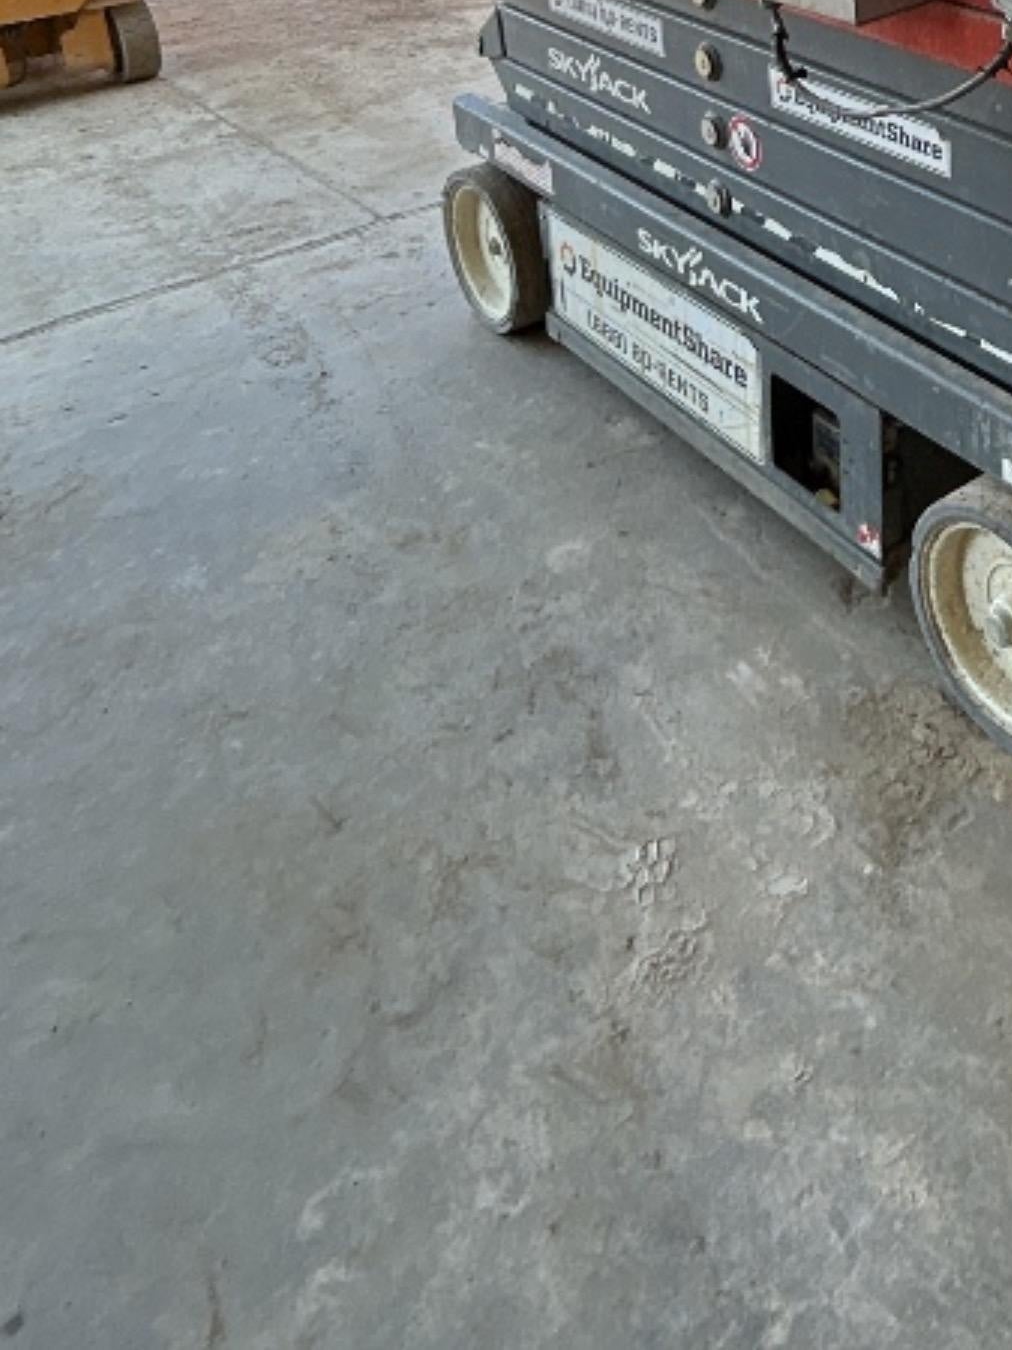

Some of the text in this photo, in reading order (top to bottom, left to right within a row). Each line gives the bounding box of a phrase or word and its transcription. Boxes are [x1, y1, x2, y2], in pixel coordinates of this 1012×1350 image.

[548, 47, 652, 115] SKYJACK
[579, 253, 748, 388] EquipmentShare
[637, 227, 764, 324] SKYJACK
